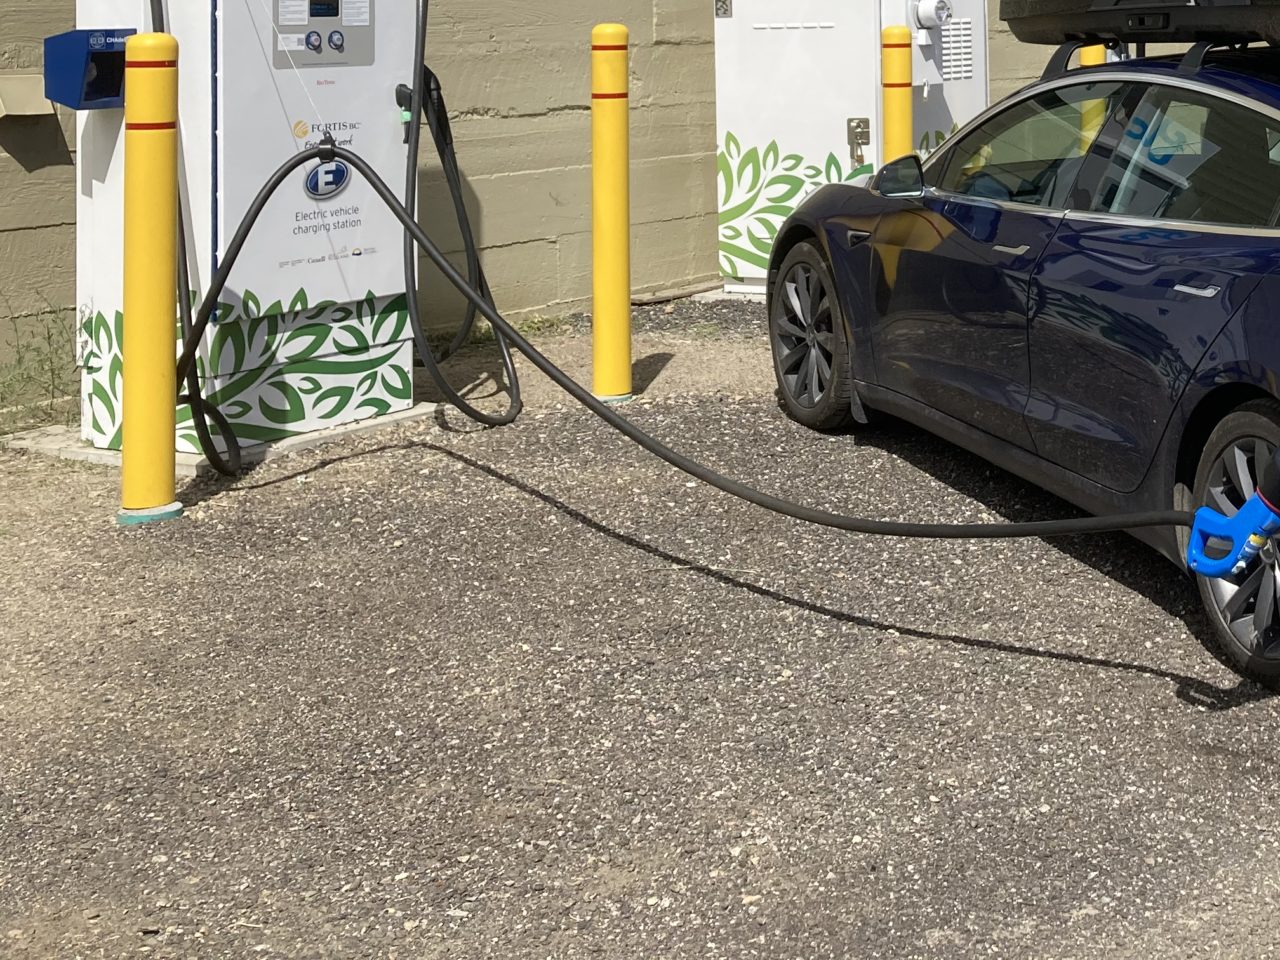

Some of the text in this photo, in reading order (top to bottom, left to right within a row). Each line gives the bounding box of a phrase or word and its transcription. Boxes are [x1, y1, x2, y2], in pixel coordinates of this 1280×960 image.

[295, 205, 359, 222] Electric vehicle
[293, 217, 361, 236] charging station
